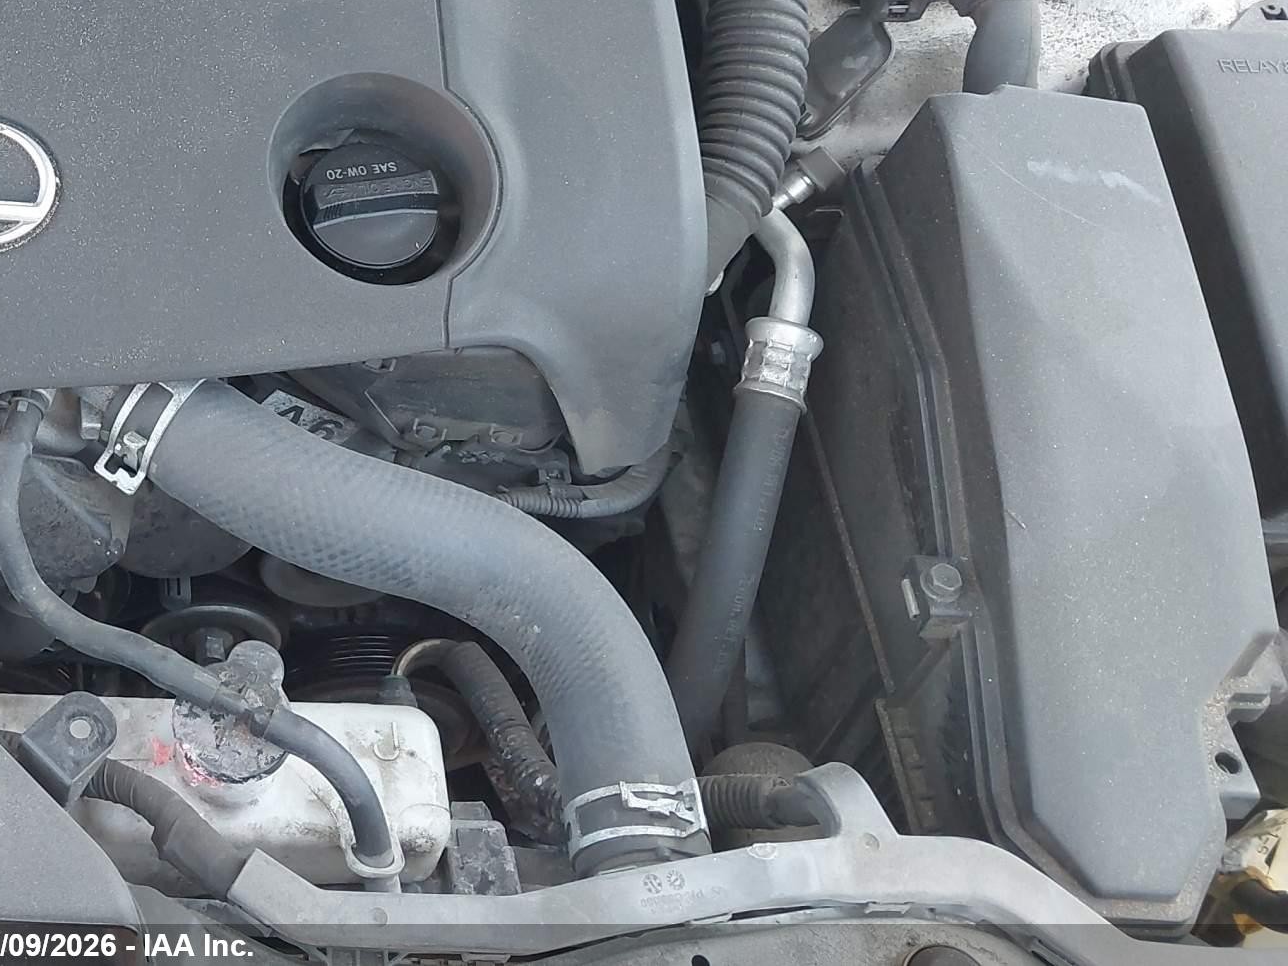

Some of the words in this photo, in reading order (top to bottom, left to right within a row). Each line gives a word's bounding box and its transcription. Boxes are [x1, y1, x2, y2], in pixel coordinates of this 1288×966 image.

[326, 166, 367, 180] 0W-20
[371, 162, 398, 174] SAE
[380, 177, 431, 192] ENGE
